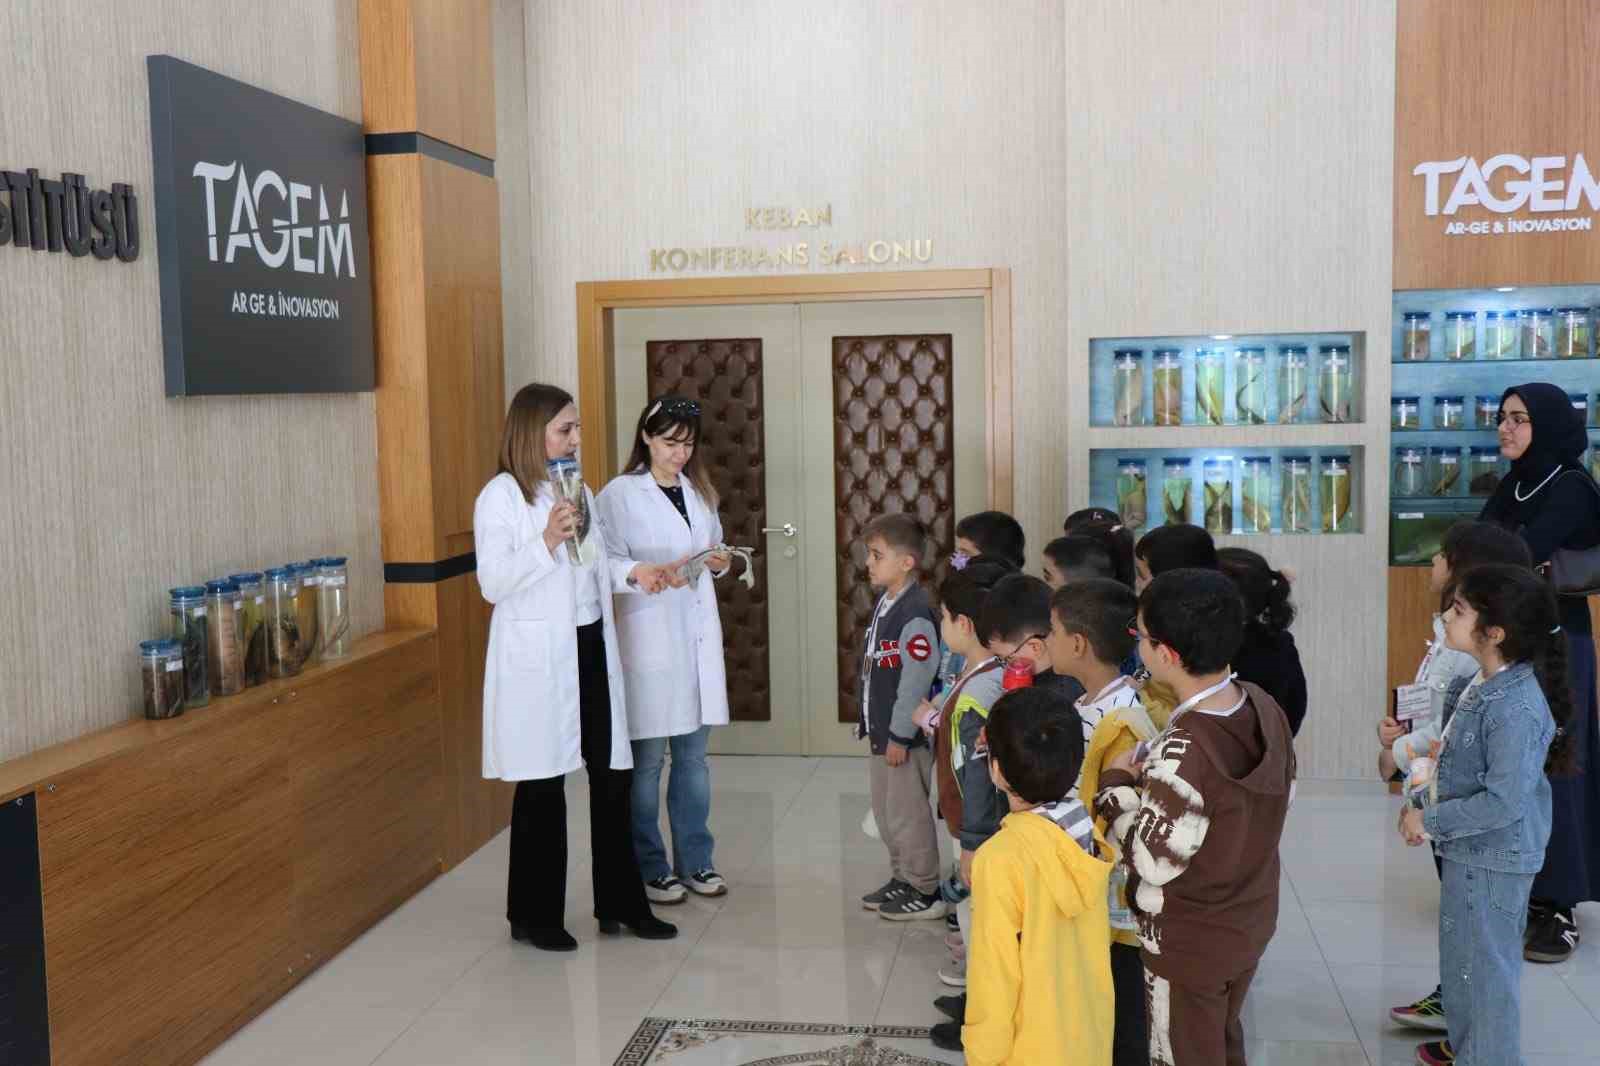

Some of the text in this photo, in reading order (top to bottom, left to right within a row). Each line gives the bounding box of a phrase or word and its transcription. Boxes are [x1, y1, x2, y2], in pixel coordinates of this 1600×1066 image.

[193, 160, 356, 278] TAGEM
[746, 205, 832, 229] KEBAN
[1444, 217, 1592, 236] AR-GE & İNOVASYON
[650, 240, 934, 272] KONFERANS SALONU
[268, 294, 277, 315] &
[278, 291, 340, 320] İNOVASYON
